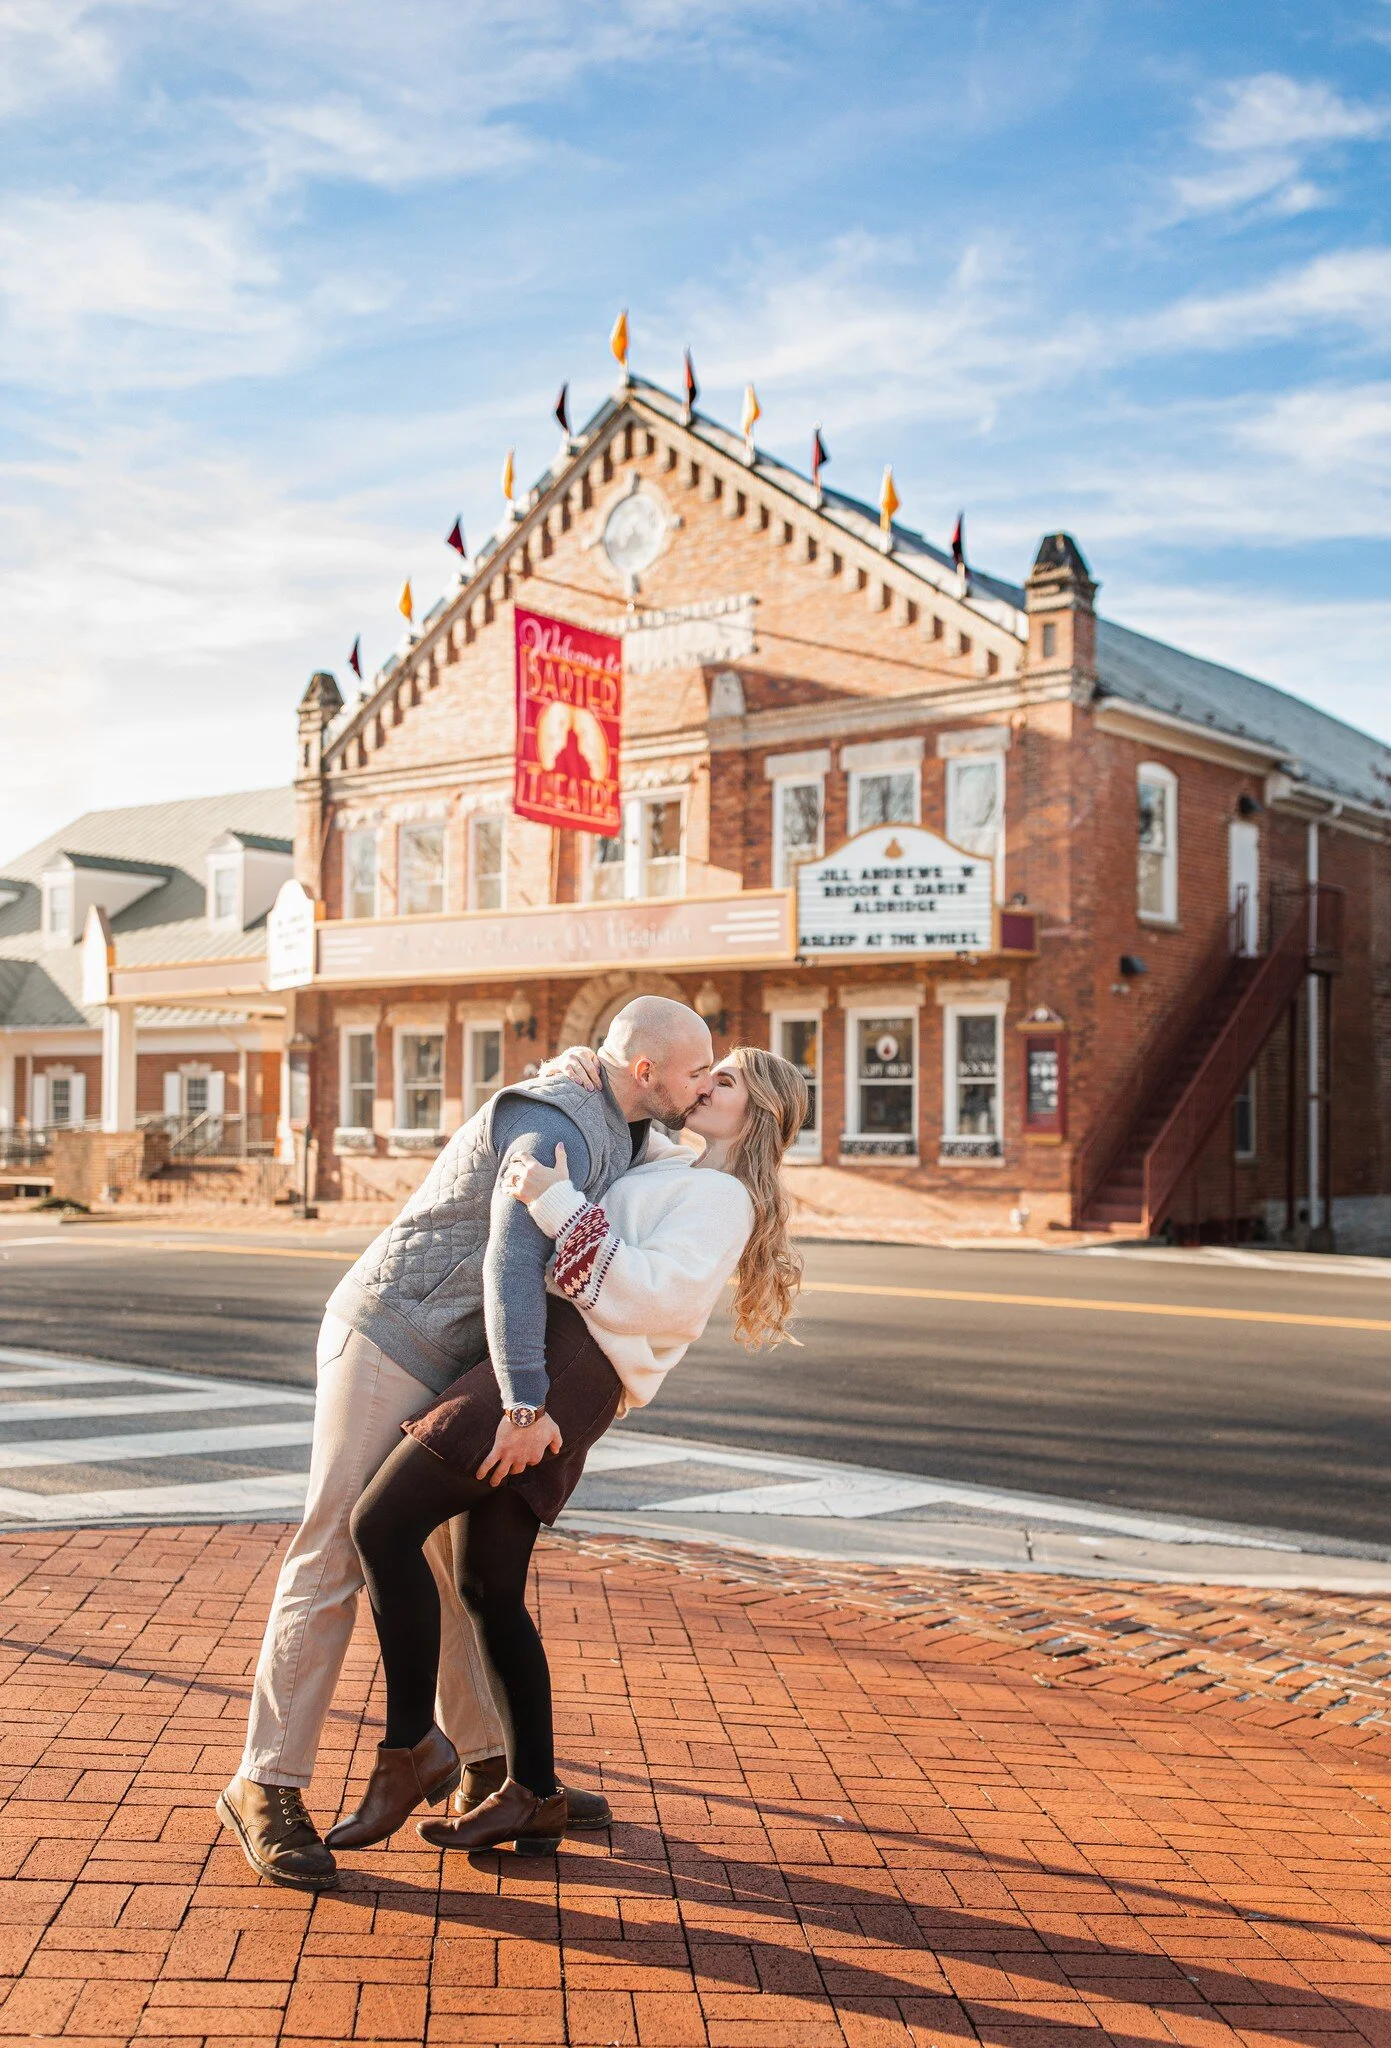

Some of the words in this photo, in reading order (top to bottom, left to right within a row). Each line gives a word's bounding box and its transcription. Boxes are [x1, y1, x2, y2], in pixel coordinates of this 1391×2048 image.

[522, 648, 619, 715] BARTER
[525, 763, 619, 822] THEATRE
[818, 868, 850, 881] JILL
[861, 866, 942, 880] ANDREWS
[853, 901, 937, 914] ALDRIDGE
[799, 934, 857, 947] ASLEEP
[866, 934, 882, 946] AT
[890, 933, 917, 946] THE
[924, 931, 981, 946] WHEEL
